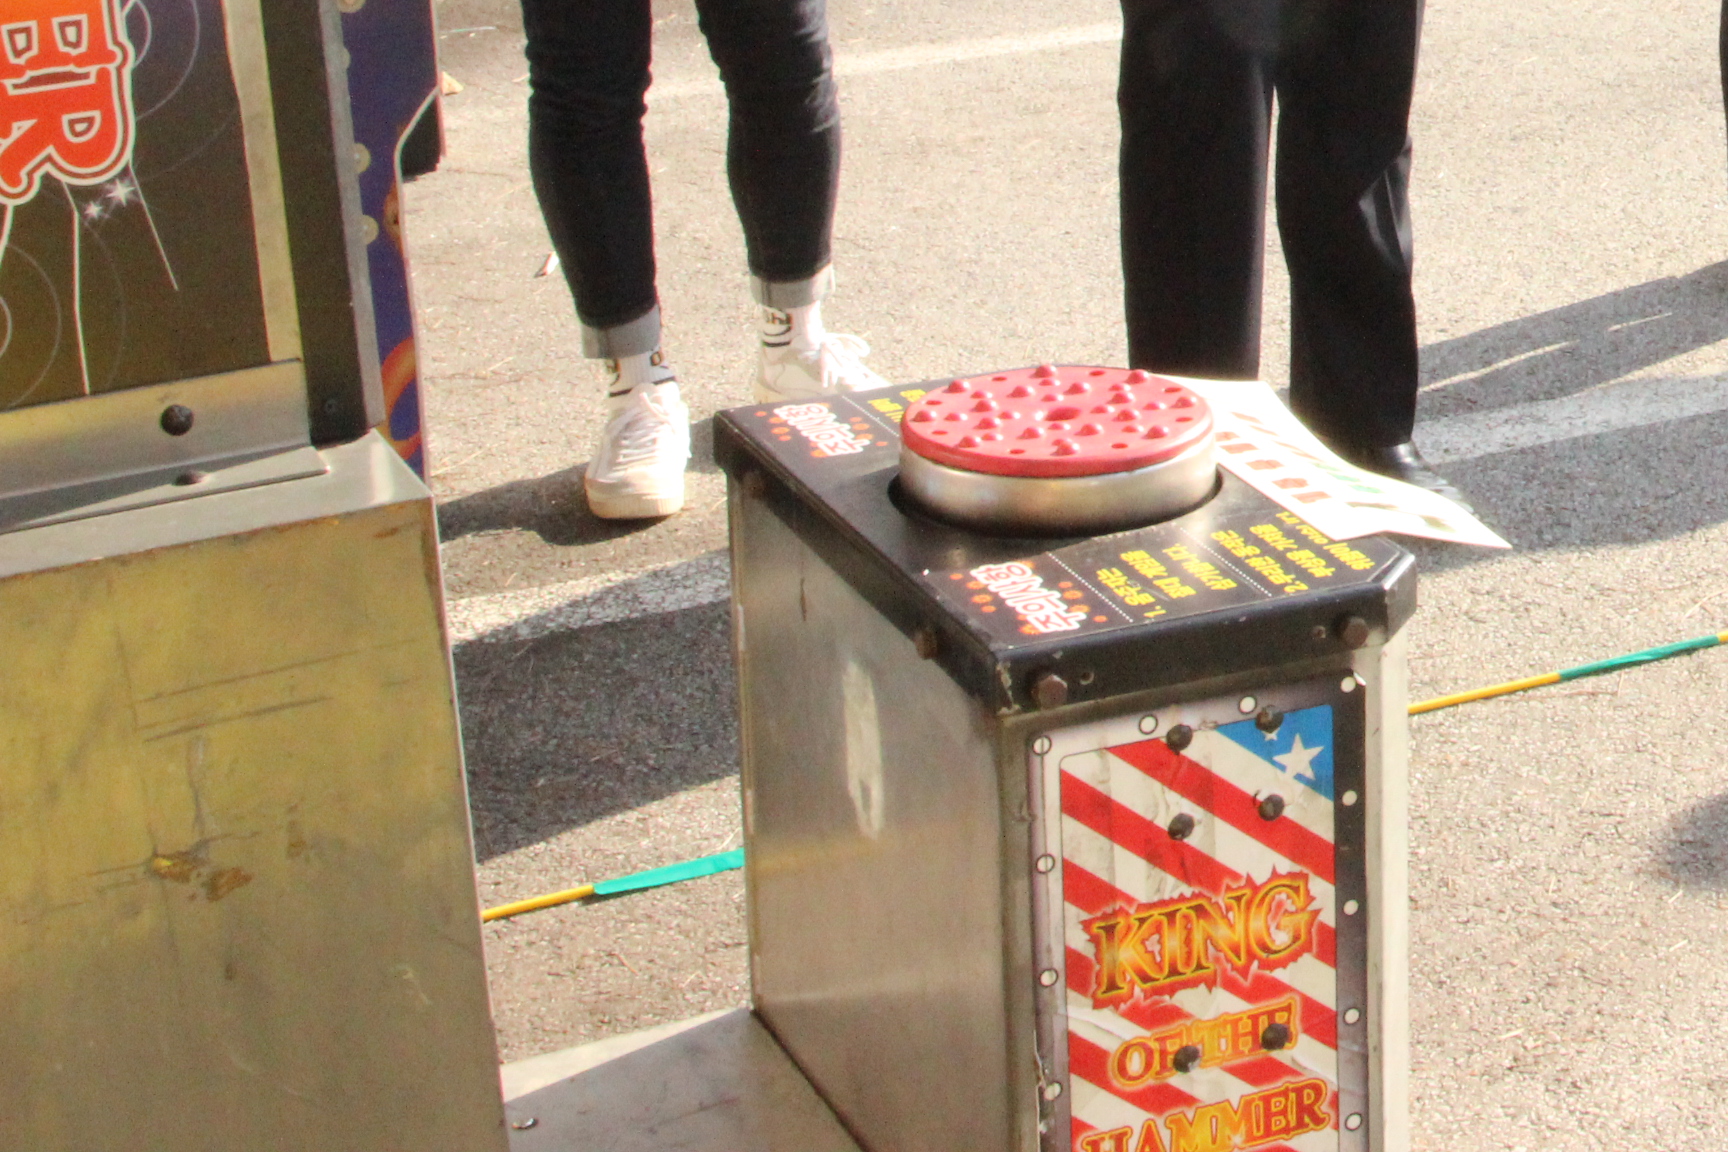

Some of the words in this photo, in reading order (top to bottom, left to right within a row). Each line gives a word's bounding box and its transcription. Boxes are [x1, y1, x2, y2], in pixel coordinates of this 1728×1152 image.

[773, 402, 871, 457] 주의사항
[1153, 576, 1197, 599] 절대
[1286, 549, 1336, 578] 부상을
[970, 561, 1087, 633] 주의사항
[1092, 879, 1312, 996] KING
[1110, 1021, 1196, 1088] OF
